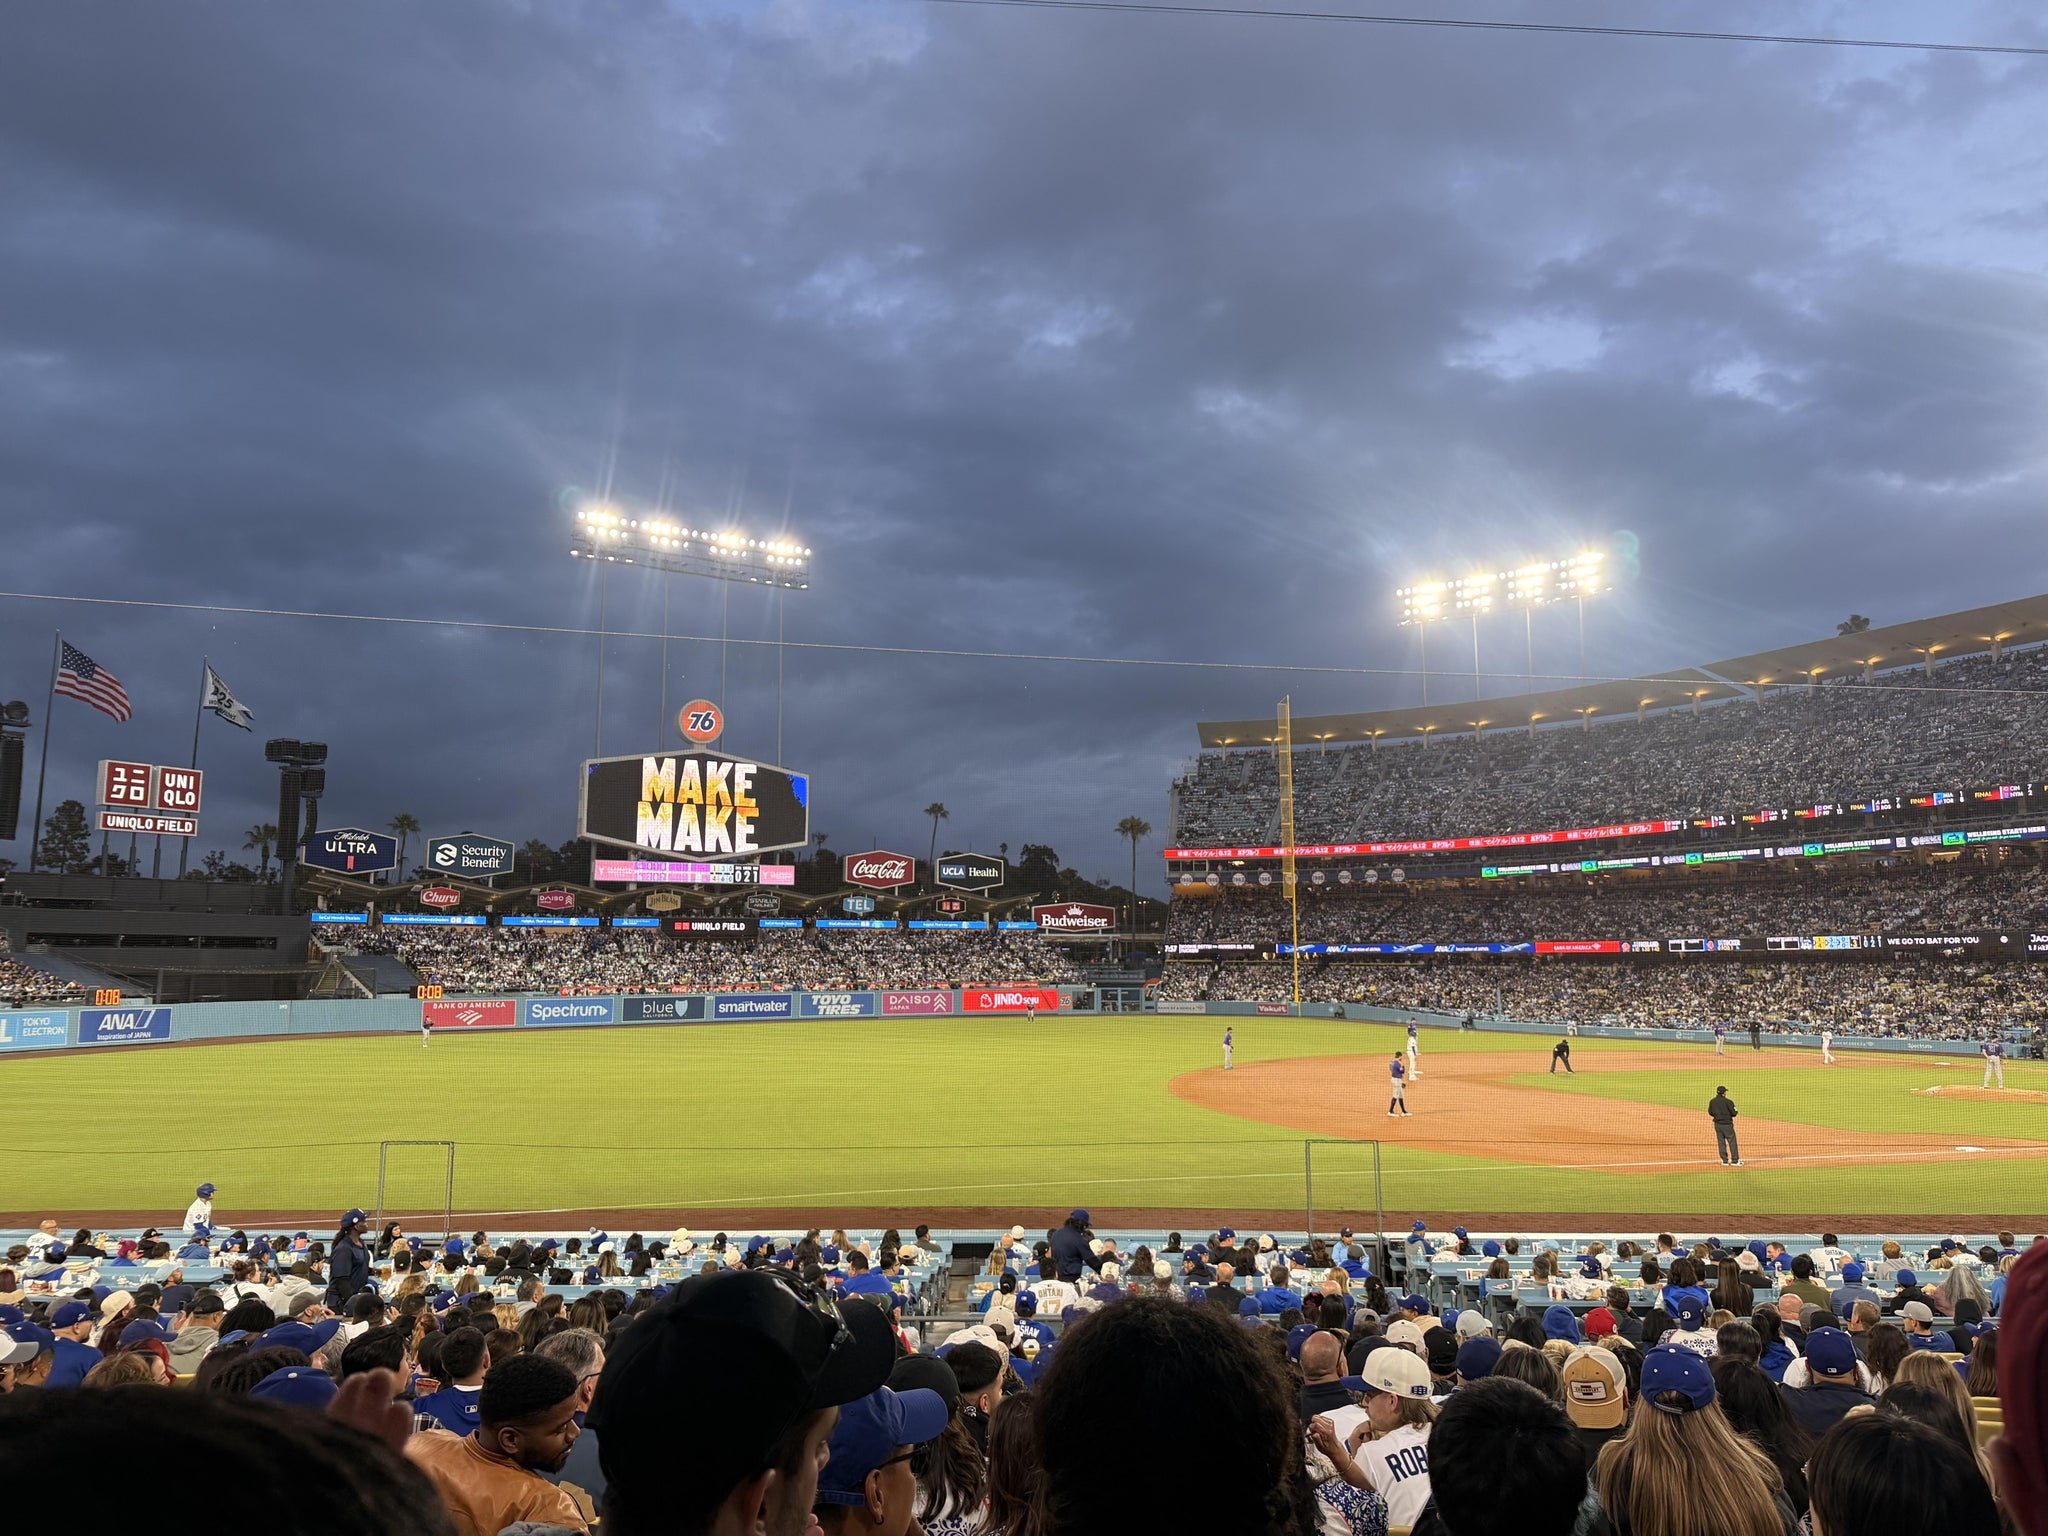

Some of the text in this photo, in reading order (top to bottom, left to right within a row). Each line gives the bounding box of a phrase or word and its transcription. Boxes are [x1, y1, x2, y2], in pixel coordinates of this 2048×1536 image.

[688, 711, 715, 732] 76
[165, 773, 194, 789] UNI
[641, 756, 757, 807] MAKE
[163, 789, 195, 806] QLO
[107, 815, 193, 833] UNIQLO FIELD
[636, 801, 759, 853] MAKE
[325, 841, 377, 854] ULTRA
[461, 844, 507, 859] Security
[461, 856, 501, 868] Benefit
[852, 859, 908, 879] Coca-Cola
[735, 871, 742, 882] 0
[744, 871, 750, 882] 2
[753, 871, 758, 882] 1
[942, 867, 998, 877] UCLA Health
[422, 890, 458, 904] Churu
[847, 899, 871, 910] TEL
[691, 922, 720, 931] UNIQLO
[722, 922, 746, 931] FIELD
[1962, 936, 1979, 944] YOU
[95, 989, 121, 1006] 0:08
[418, 985, 442, 999] 0:08
[469, 1001, 506, 1009] AMERICA
[718, 1000, 788, 1013] smartwater
[811, 995, 851, 1005] TOYO
[889, 995, 931, 1004] DAISO
[994, 993, 1023, 1008] JINRO
[531, 1003, 604, 1021] Spectrum
[642, 1000, 673, 1014] blue
[817, 1005, 861, 1015] TIRES
[22, 1017, 50, 1027] TOKYO
[98, 1013, 134, 1031] ANA
[23, 1027, 65, 1037] ELECTRON
[1038, 1288, 1063, 1297] OHTANI
[1042, 1300, 1061, 1314] 17
[1018, 1324, 1040, 1338] SHAW
